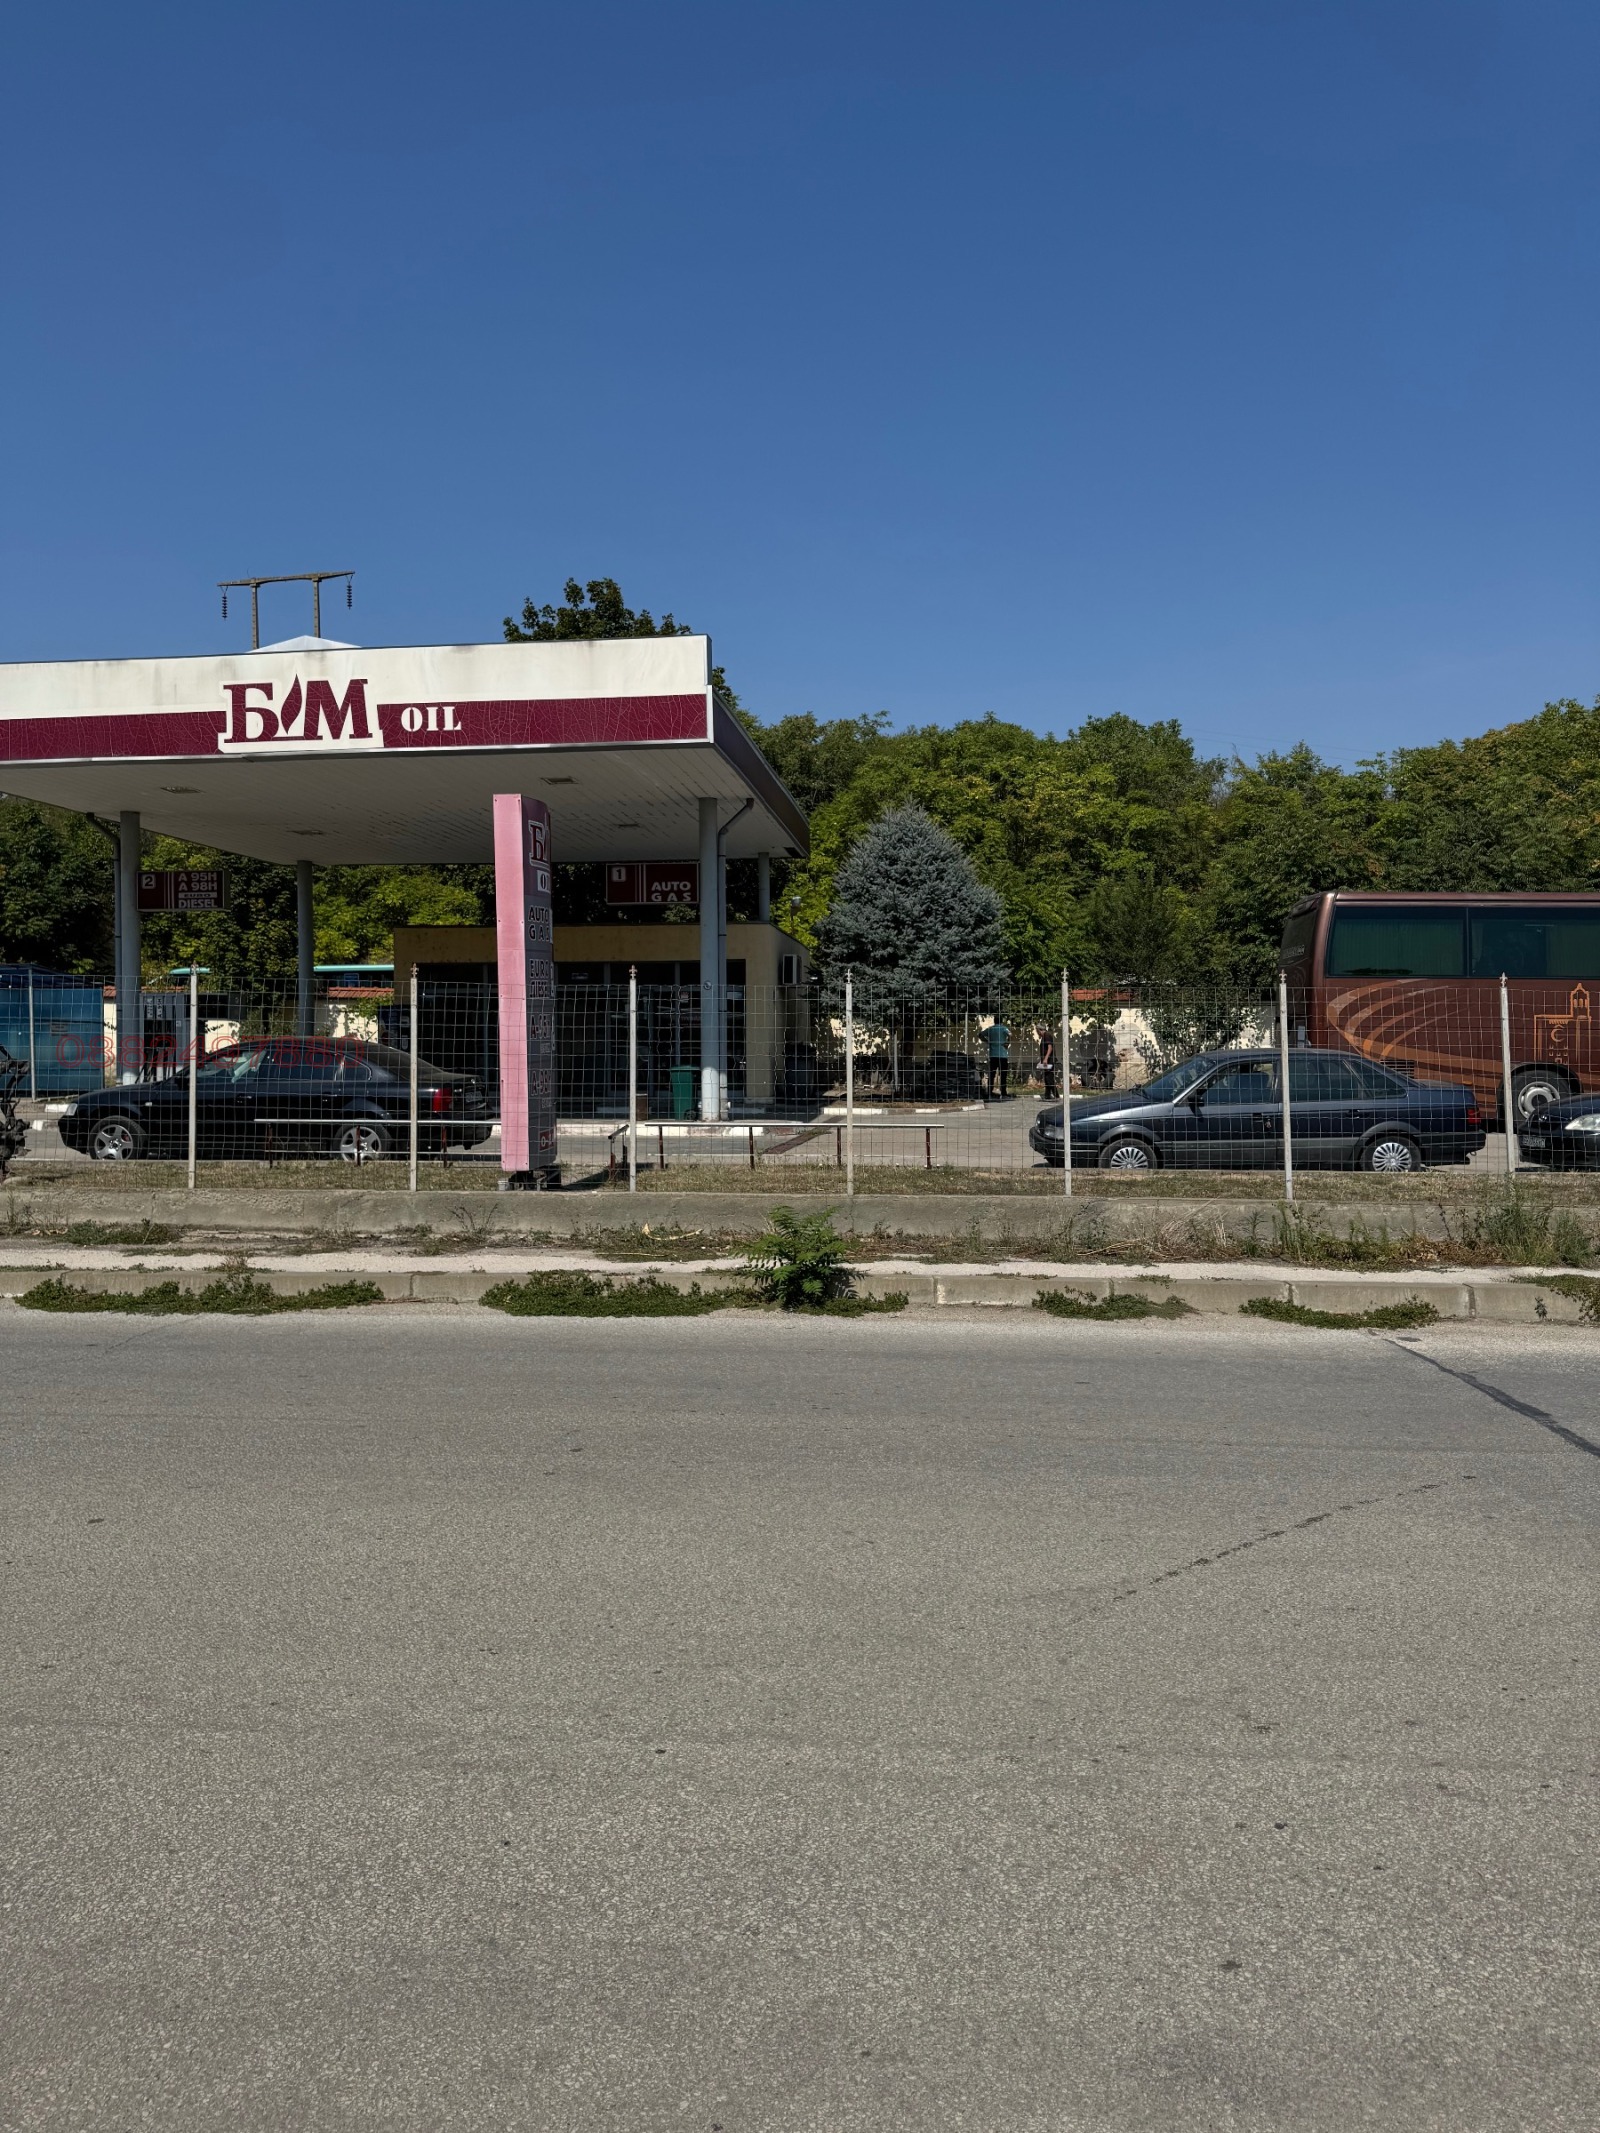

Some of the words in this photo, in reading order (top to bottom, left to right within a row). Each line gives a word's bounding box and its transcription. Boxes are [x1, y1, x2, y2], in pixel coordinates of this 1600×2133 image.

[401, 705, 462, 732] OIL
[144, 875, 154, 888] 2
[651, 881, 692, 891] AUTO
[178, 898, 218, 909] DIESEL
[528, 906, 549, 924] AUTO
